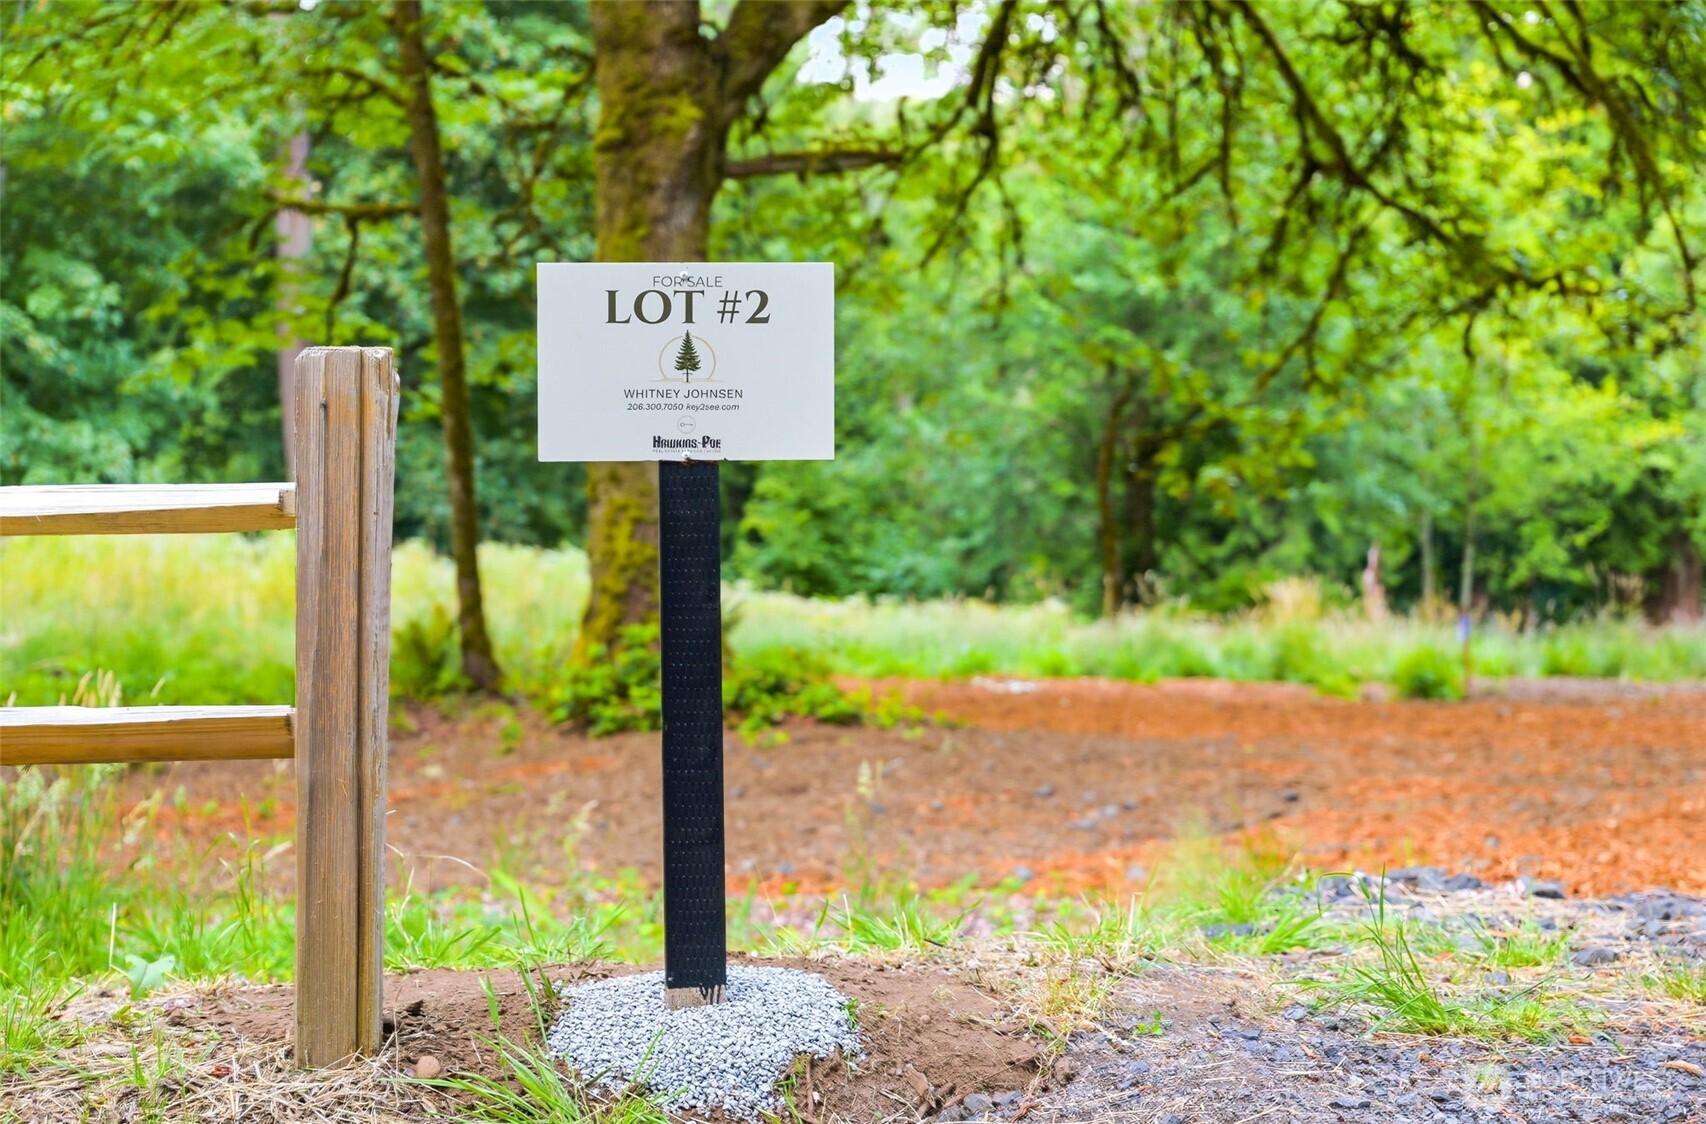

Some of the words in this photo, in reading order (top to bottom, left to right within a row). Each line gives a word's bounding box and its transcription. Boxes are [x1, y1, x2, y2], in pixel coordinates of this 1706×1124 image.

[653, 275, 683, 288] FOR
[687, 275, 723, 288] SALE
[604, 289, 705, 325] LOT
[716, 289, 771, 324] #2
[623, 388, 681, 399] WHITNEY
[683, 388, 743, 399] JOHNSEN
[627, 402, 684, 411] 206.300.7050
[686, 402, 740, 413] key2see.com
